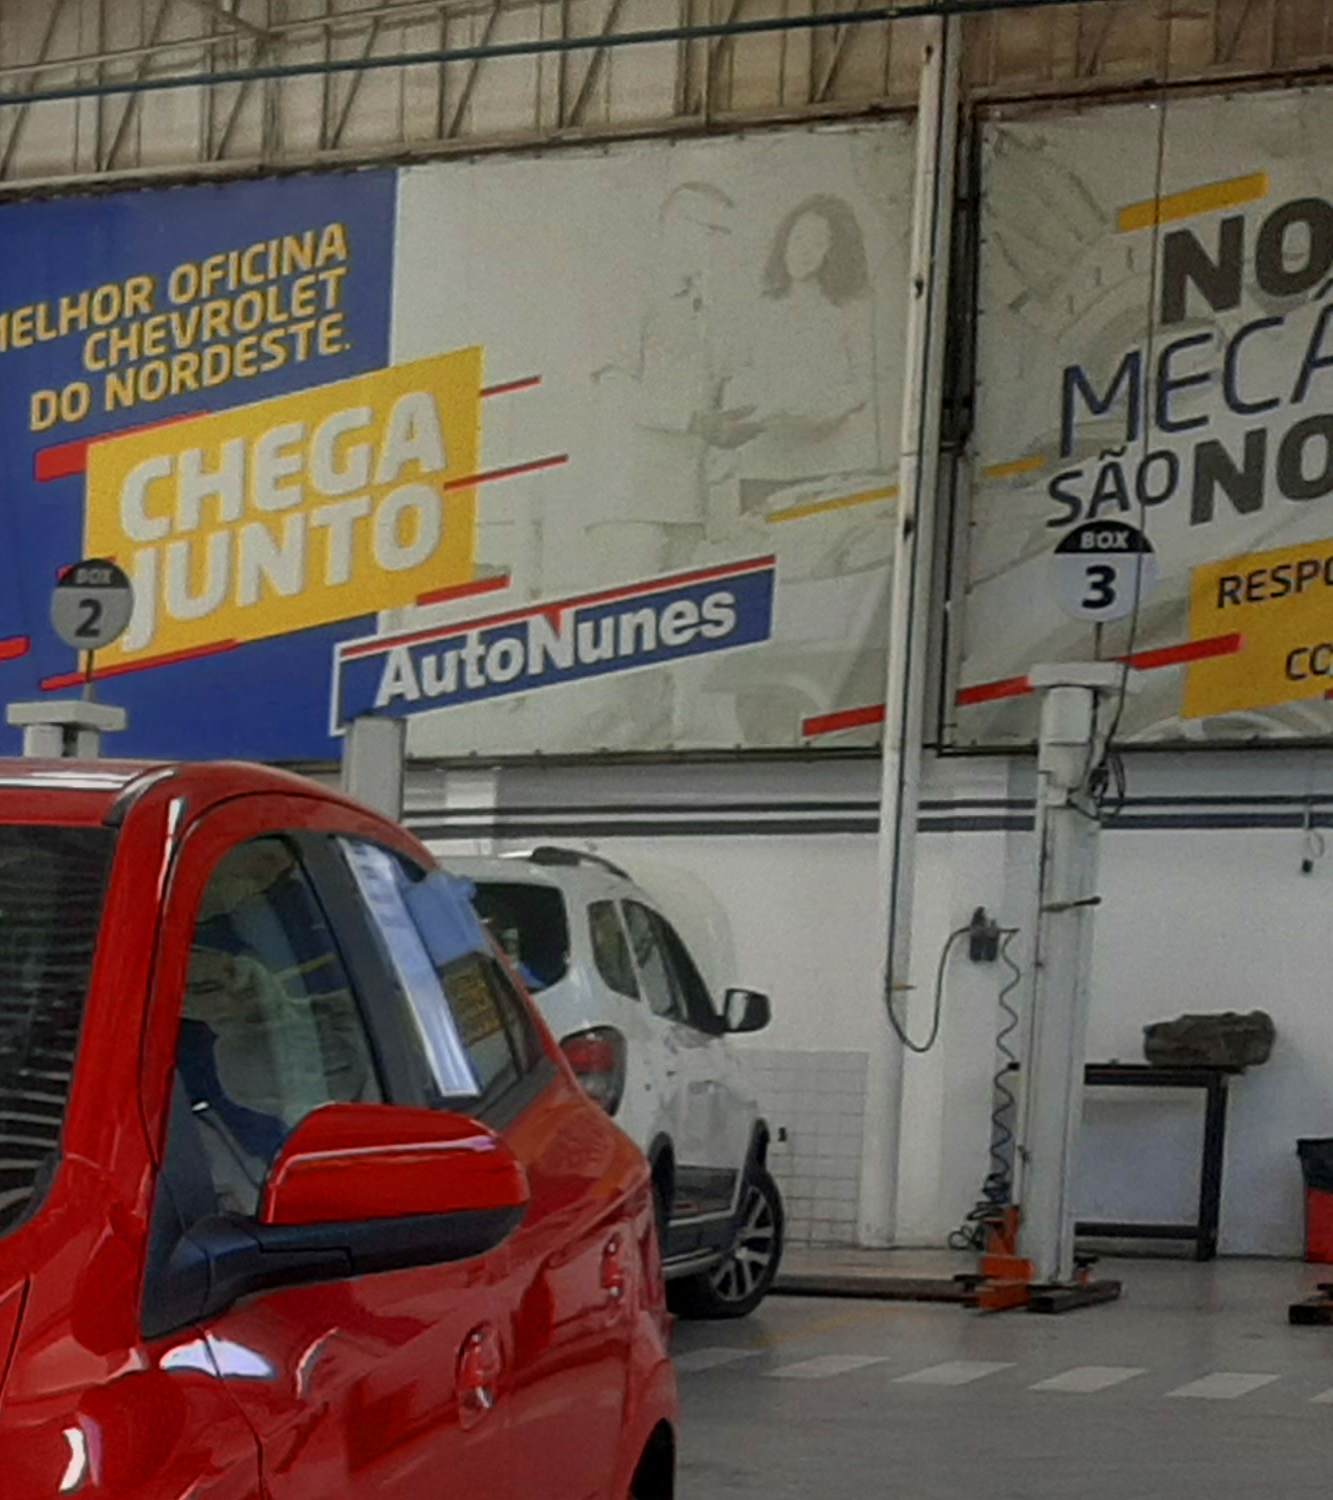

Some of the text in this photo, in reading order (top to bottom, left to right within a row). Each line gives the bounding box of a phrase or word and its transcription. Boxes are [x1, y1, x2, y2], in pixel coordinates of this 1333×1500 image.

[168, 221, 349, 305] OFICINA
[83, 265, 348, 372] CHEVROLET
[29, 325, 351, 432] DO NORDESTE.
[119, 390, 445, 542] CHEGA
[1046, 445, 1178, 528] SÃO
[77, 569, 113, 584] BOX
[119, 484, 443, 652] JUNTO
[1080, 531, 1130, 551] BOX
[75, 599, 103, 637] 2
[1081, 565, 1116, 609] 3
[374, 590, 737, 707] AutoNunes
